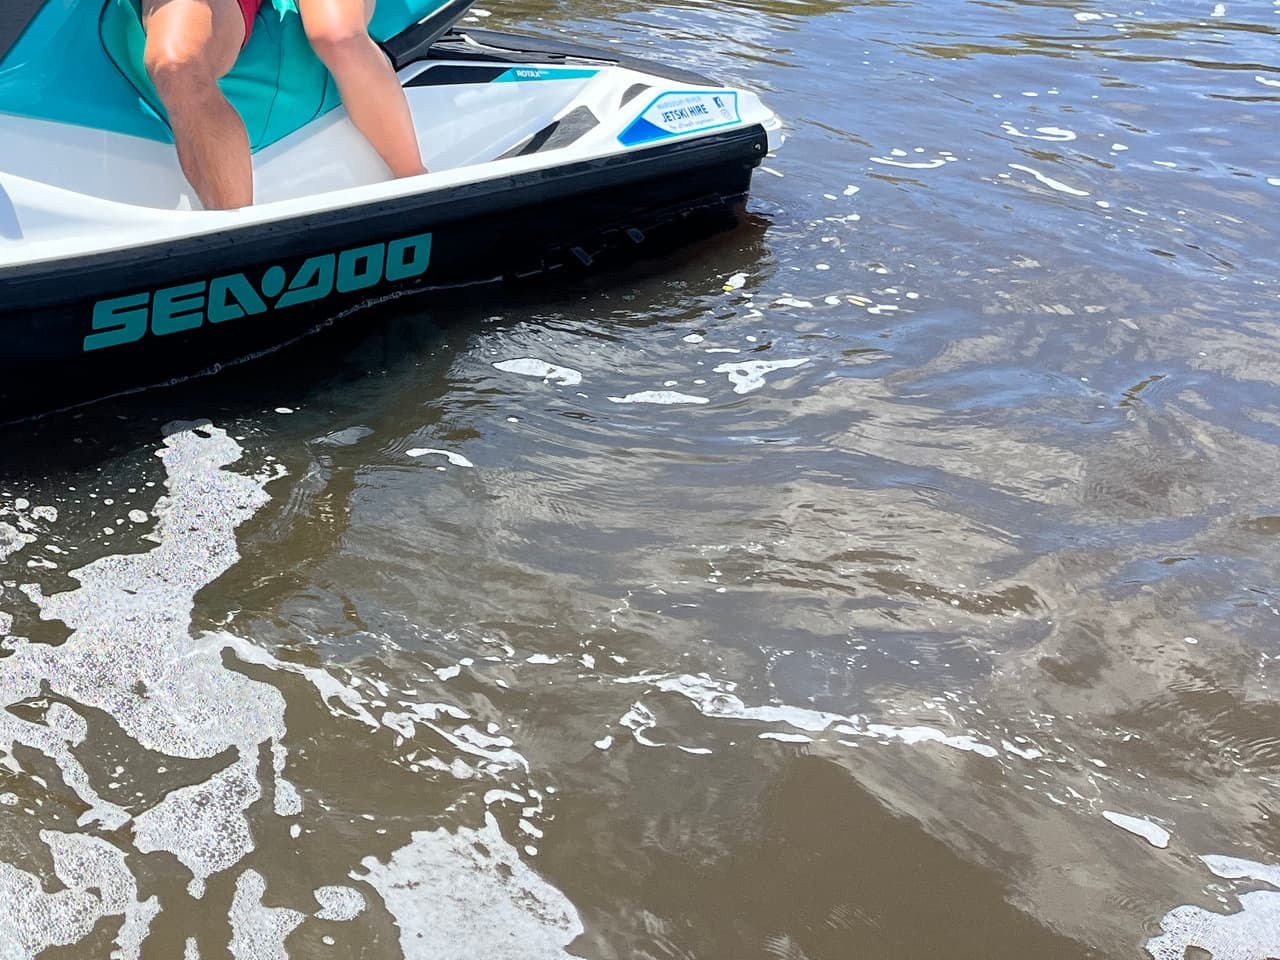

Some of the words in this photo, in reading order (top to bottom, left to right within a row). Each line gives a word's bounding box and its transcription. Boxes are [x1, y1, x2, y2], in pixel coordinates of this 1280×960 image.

[516, 70, 541, 78] ROTAX
[662, 108, 690, 123] JETSKI
[687, 104, 709, 117] HIRE
